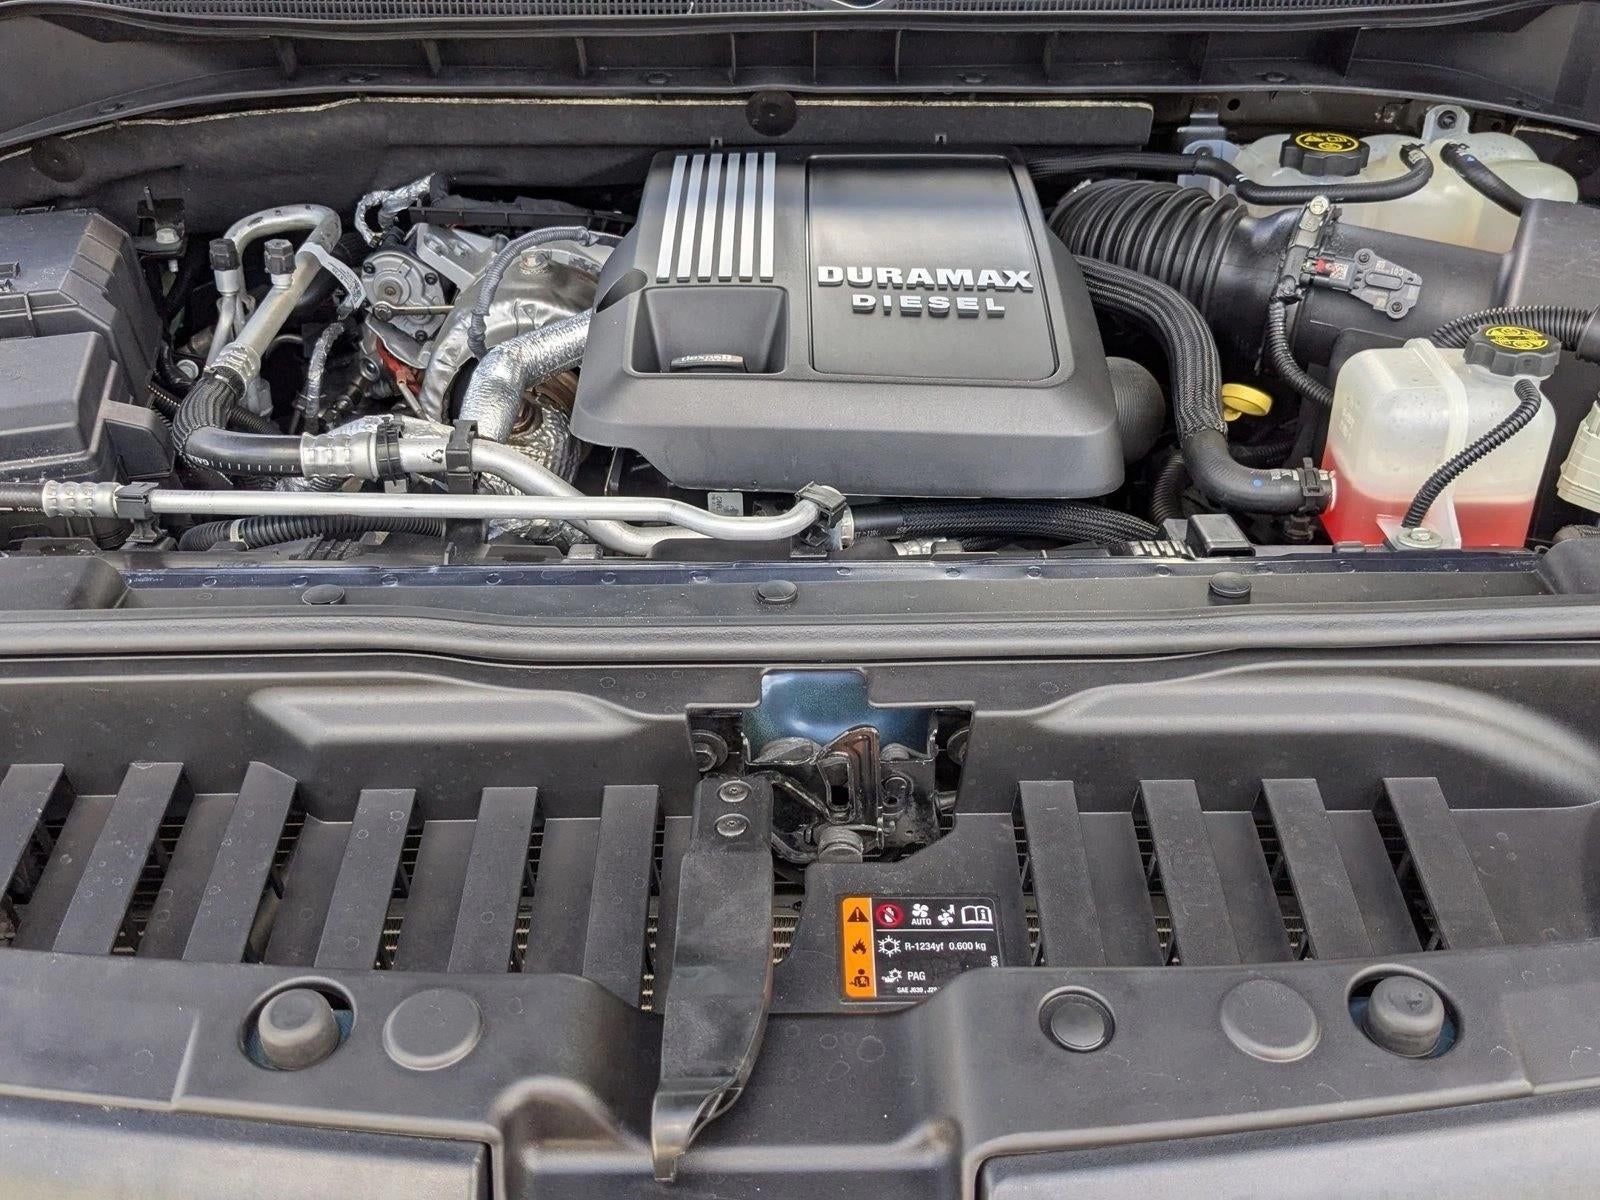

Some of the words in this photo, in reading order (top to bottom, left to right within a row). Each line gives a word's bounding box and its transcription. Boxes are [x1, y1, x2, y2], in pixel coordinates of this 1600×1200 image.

[818, 266, 1034, 292] DURAMAX
[852, 294, 1006, 318] DIESEL
[911, 917, 932, 926] AUTO
[904, 941, 944, 953] R-1234yf
[949, 941, 973, 951] 0.600
[975, 941, 987, 952] kg
[907, 971, 926, 981] PAG
[896, 986, 909, 994] SAE
